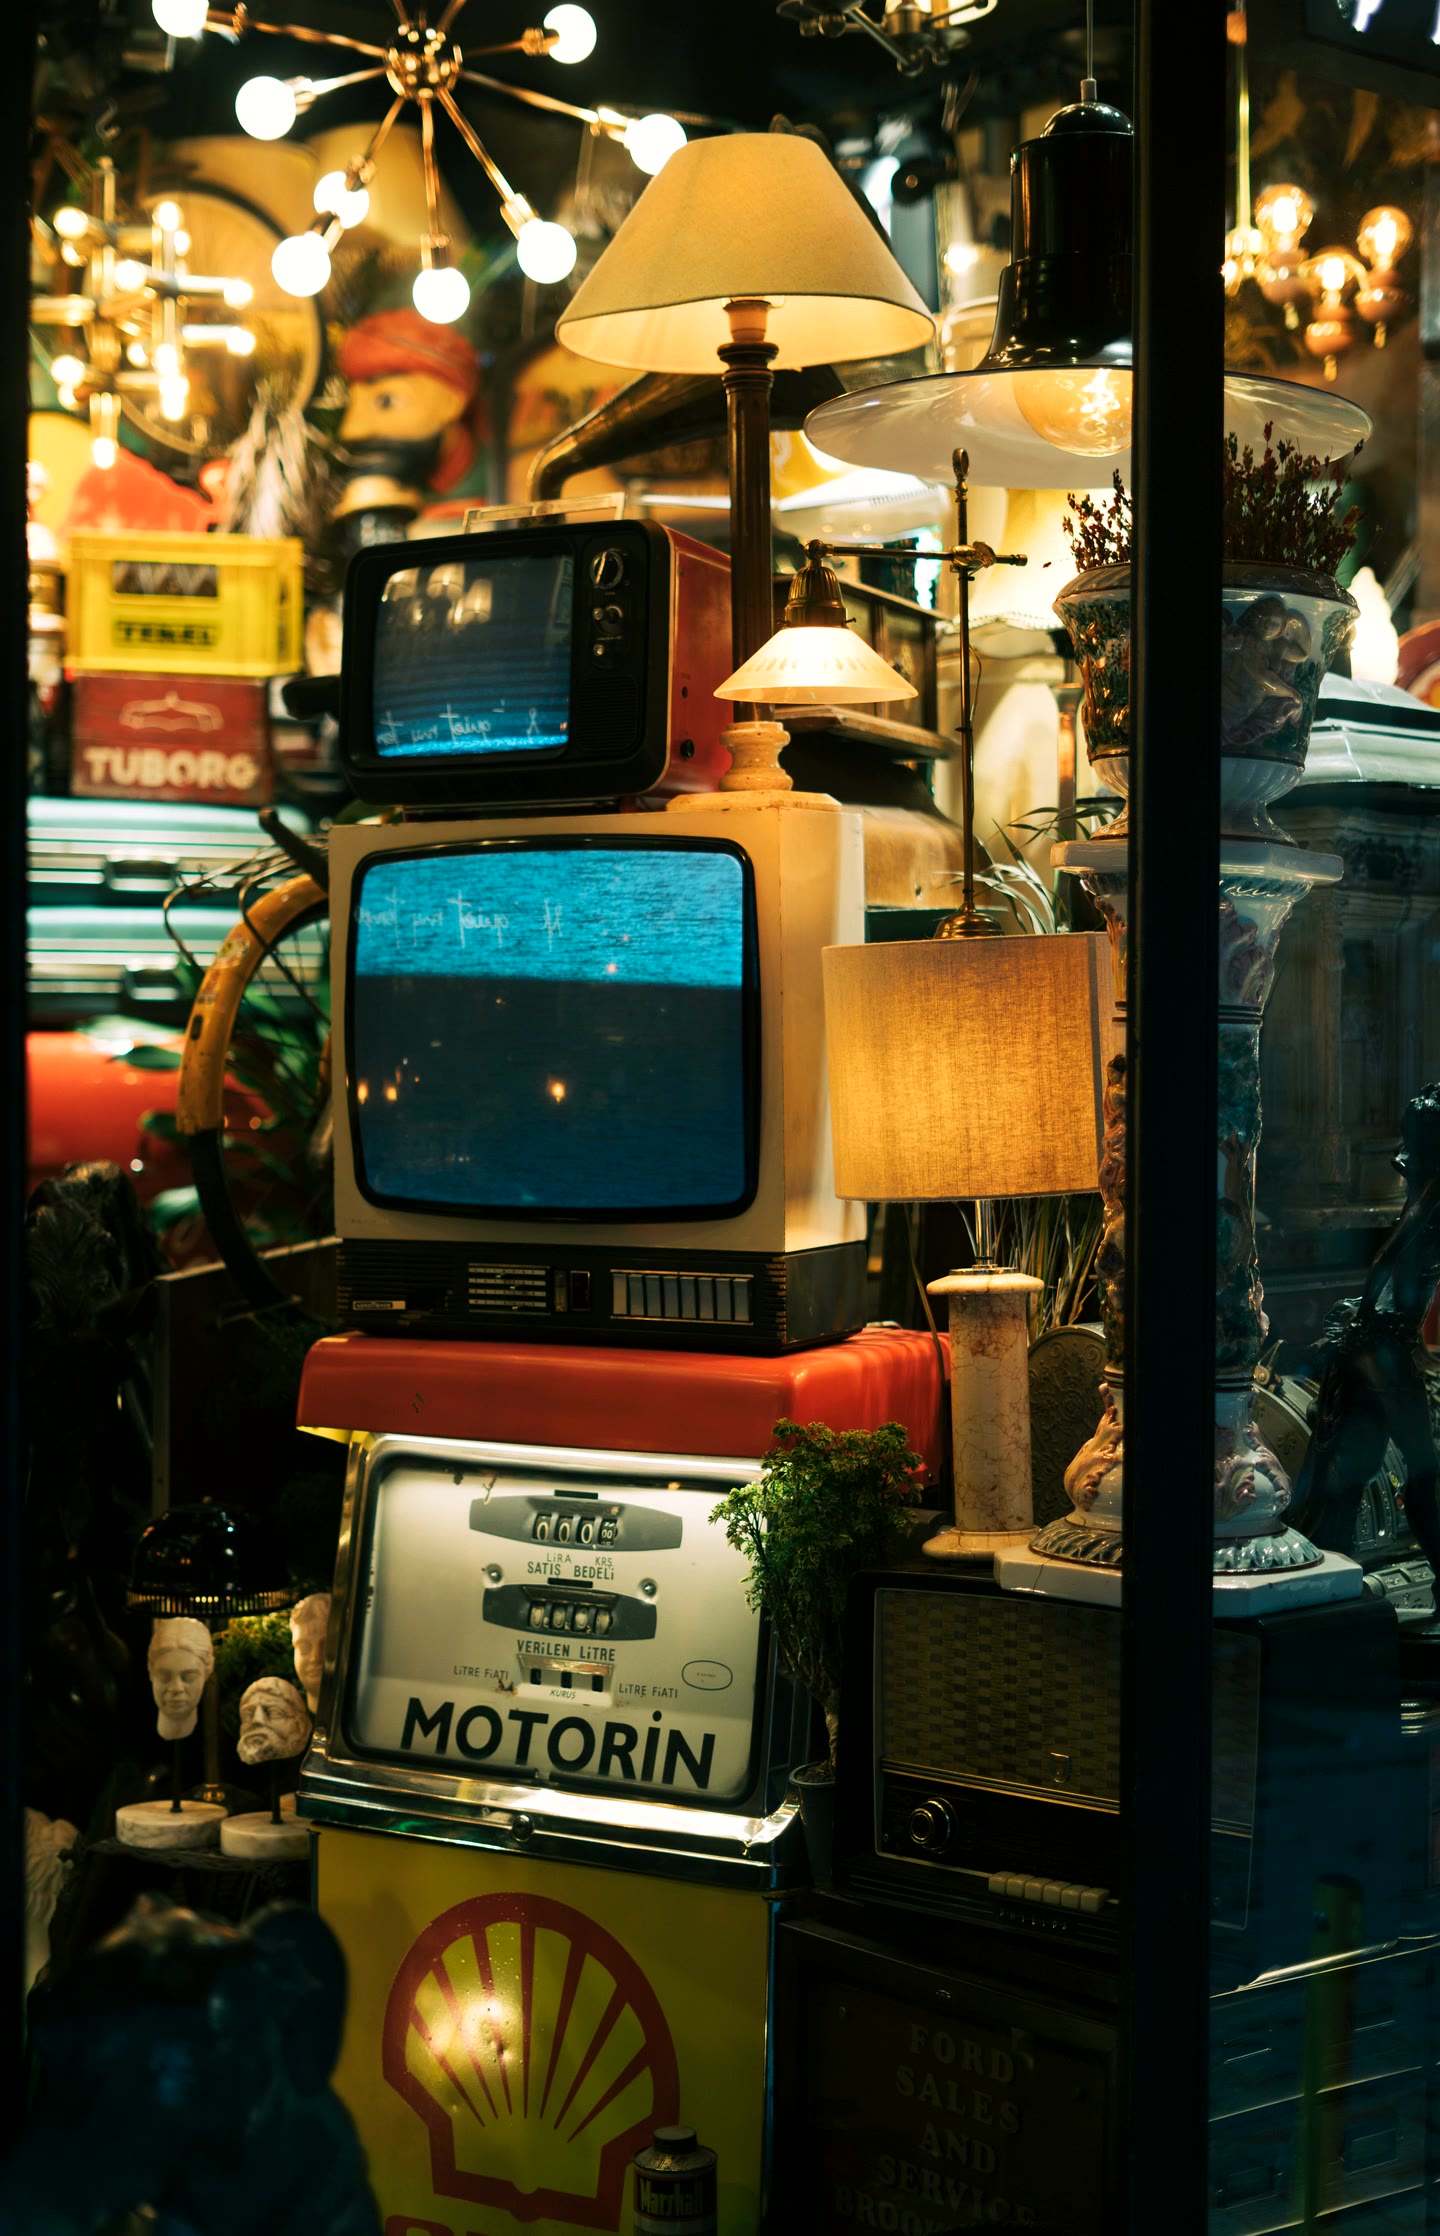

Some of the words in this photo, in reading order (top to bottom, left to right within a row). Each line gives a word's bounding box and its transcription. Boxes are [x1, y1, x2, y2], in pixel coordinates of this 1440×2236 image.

[83, 747, 260, 789] TUBORG
[910, 2024, 1015, 2083] FORD
[896, 2064, 1022, 2134] SALES
[919, 2121, 998, 2174] AND
[640, 2177, 704, 2217] Marshall
[879, 2153, 1039, 2224] SERVICE
